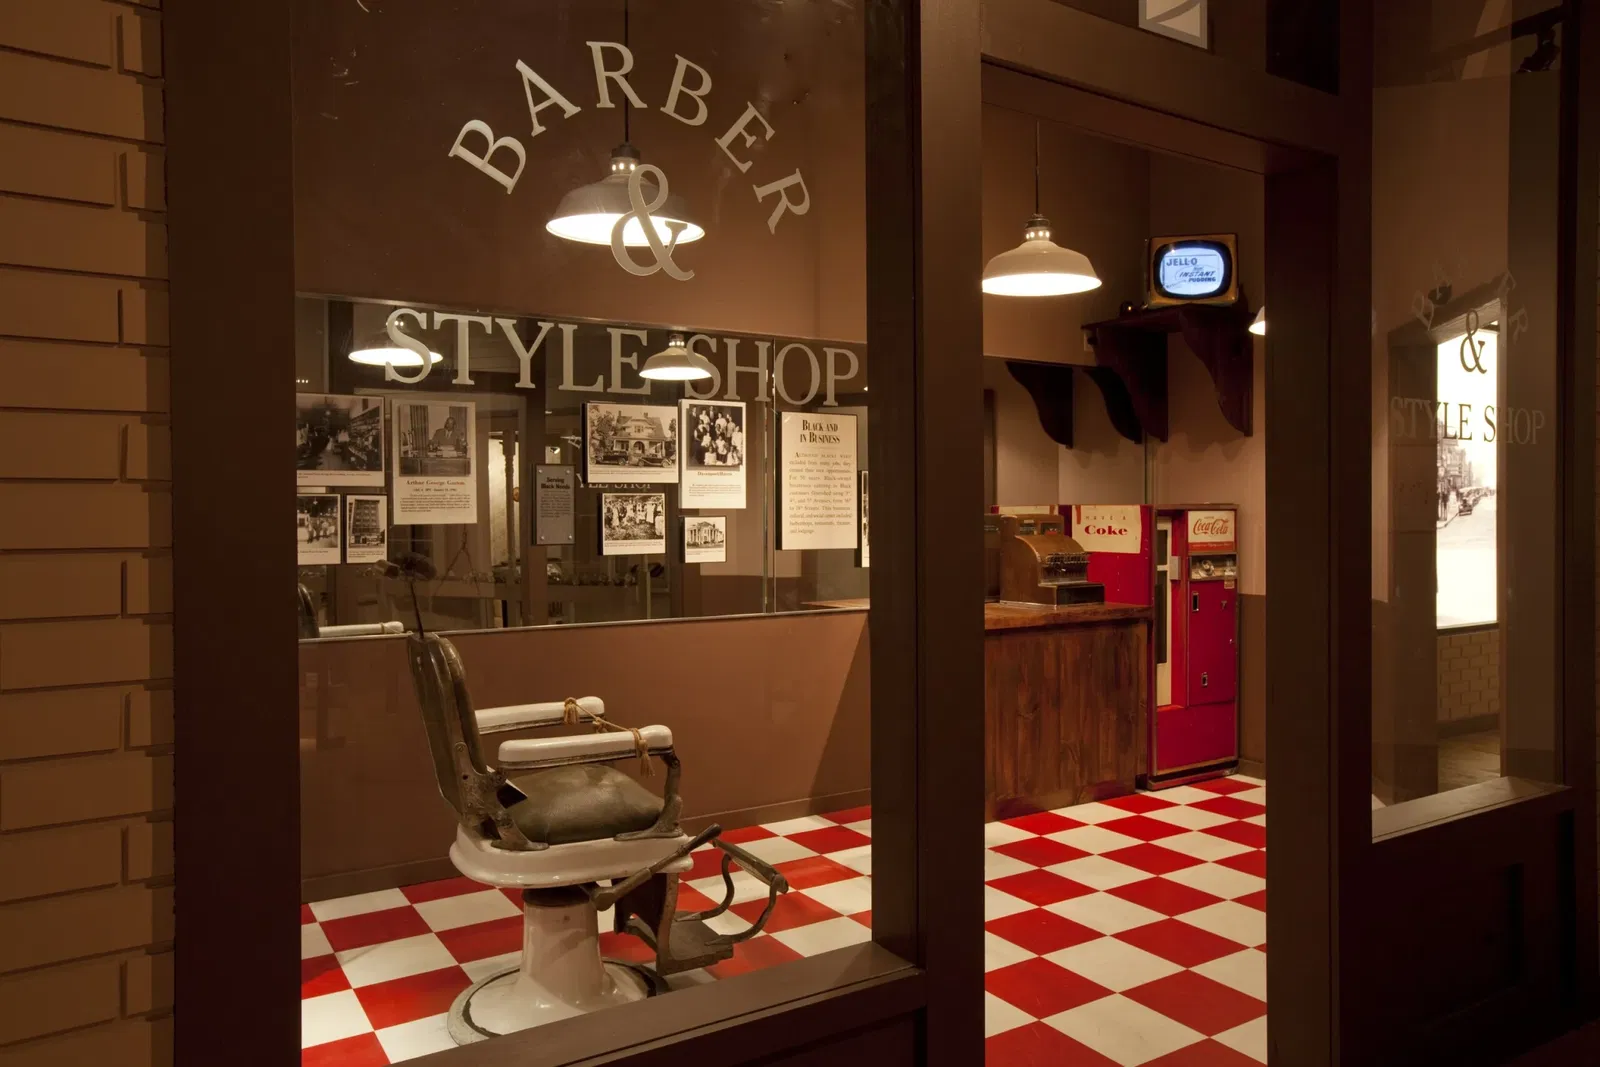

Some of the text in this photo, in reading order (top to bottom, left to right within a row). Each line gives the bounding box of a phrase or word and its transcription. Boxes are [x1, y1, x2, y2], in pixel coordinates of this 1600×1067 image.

[448, 41, 811, 234] BARBER
[610, 164, 695, 281] &
[1179, 270, 1216, 278] INSTANT
[384, 307, 860, 407] STYLE SHOP
[1460, 308, 1487, 374] &
[800, 431, 841, 444] IN BUSINESS
[802, 419, 839, 432] BLACK AND
[1390, 396, 1545, 445] STYLE SHOP
[1084, 524, 1128, 536] Coke
